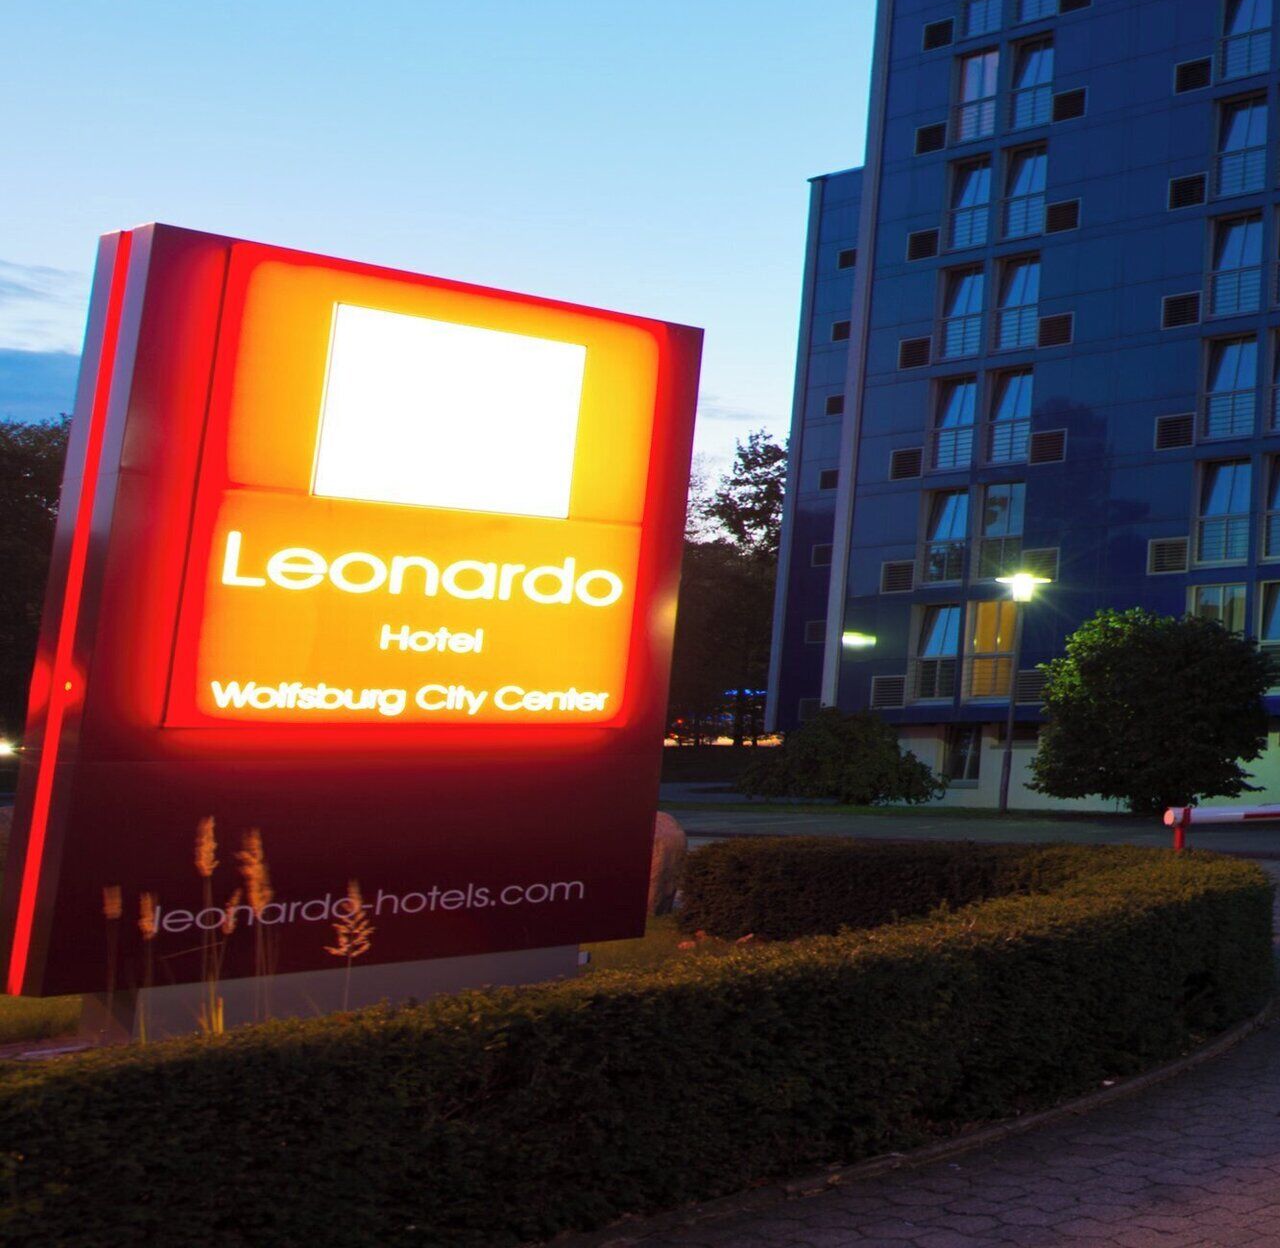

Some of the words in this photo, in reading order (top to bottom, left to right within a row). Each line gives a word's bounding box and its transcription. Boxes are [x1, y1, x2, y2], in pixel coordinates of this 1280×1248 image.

[221, 530, 624, 607] Leonardo
[379, 624, 485, 654] Hotel
[210, 680, 407, 716] Wolfsburg
[415, 684, 489, 715] City
[494, 685, 609, 712] Center
[153, 880, 585, 933] leonardo-hotels.com
